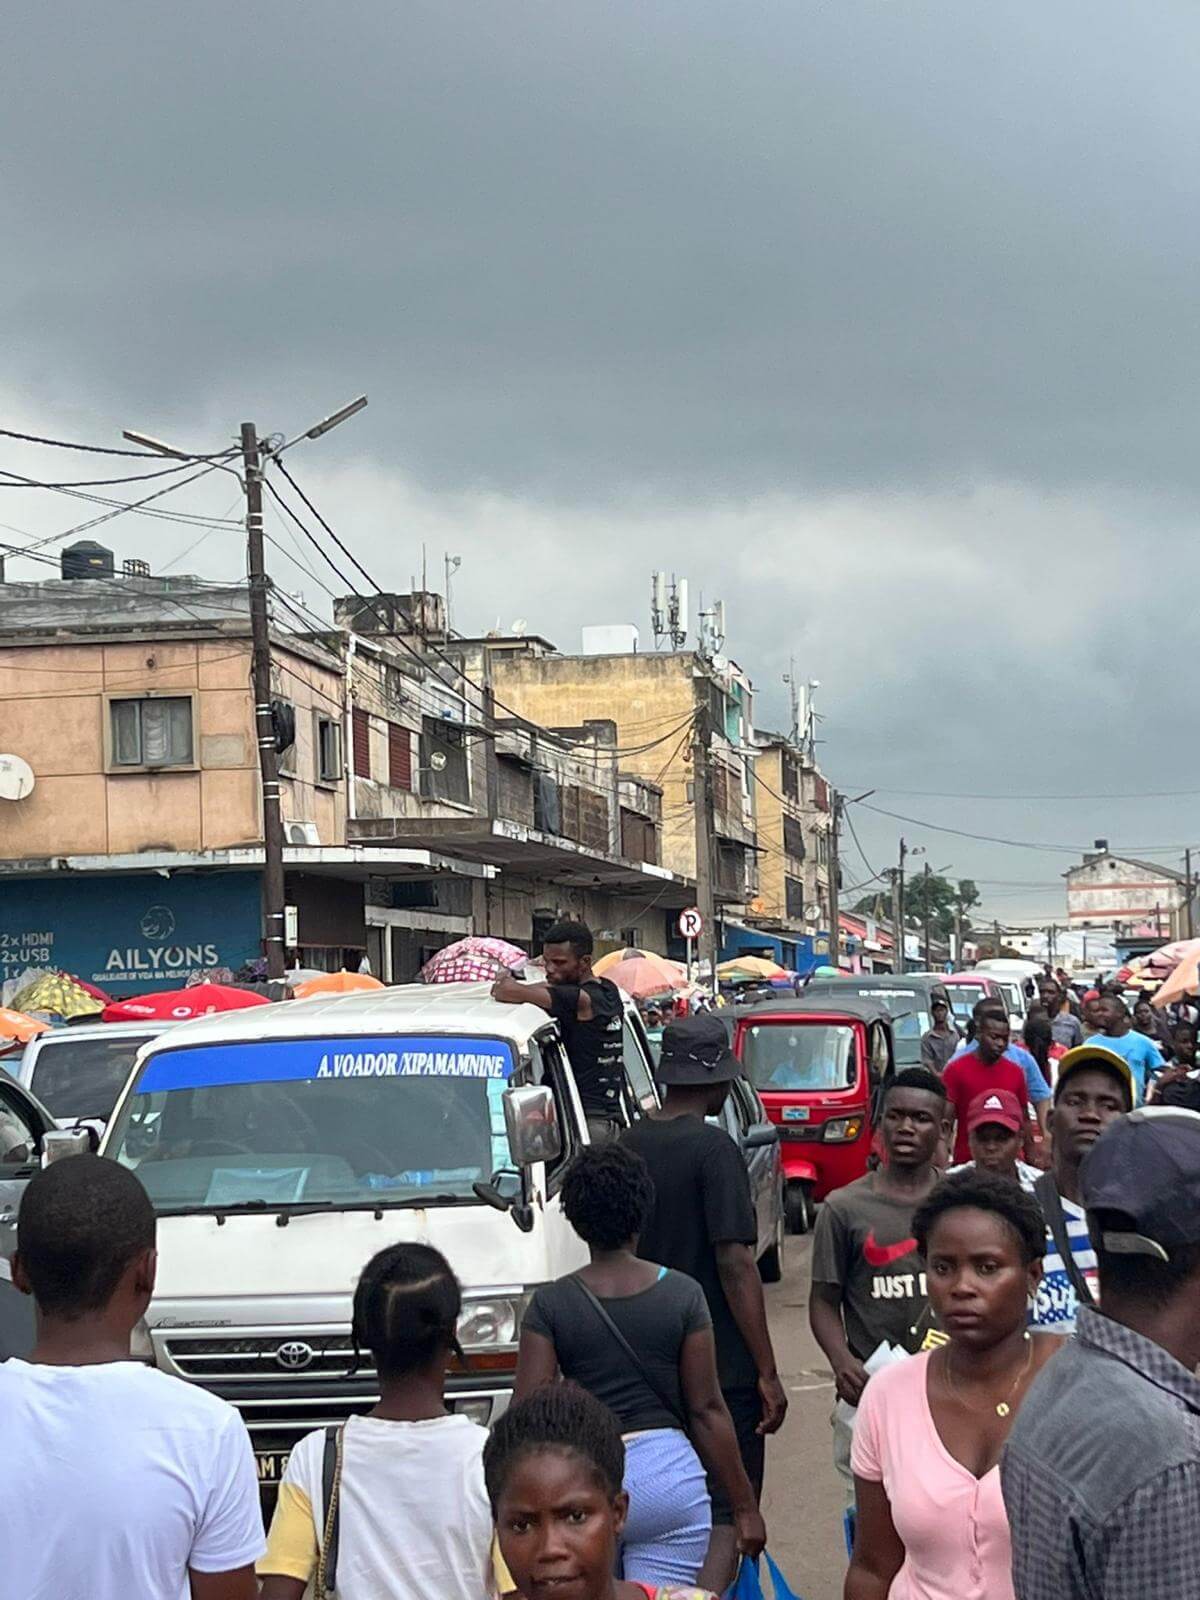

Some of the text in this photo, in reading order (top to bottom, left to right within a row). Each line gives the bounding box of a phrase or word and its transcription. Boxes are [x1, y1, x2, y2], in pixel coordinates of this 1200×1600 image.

[22, 932, 54, 945] HDMI
[20, 948, 50, 962] USB
[105, 944, 219, 971] AILYONS
[871, 1274, 914, 1298] JUST
